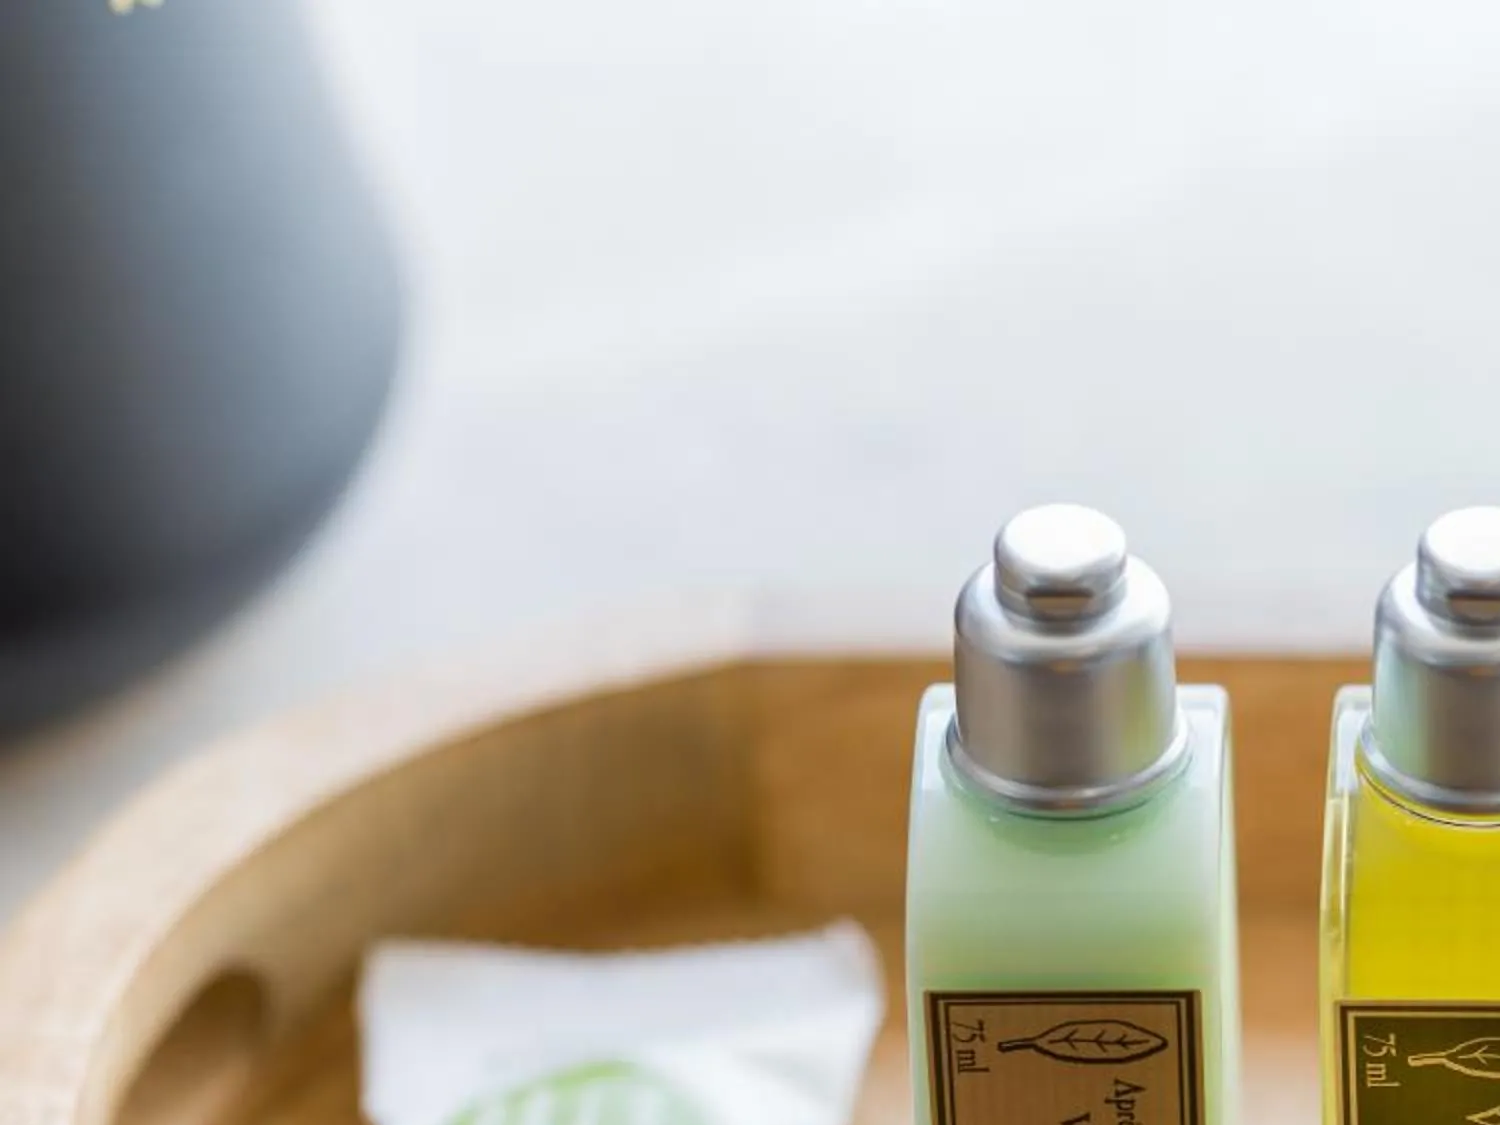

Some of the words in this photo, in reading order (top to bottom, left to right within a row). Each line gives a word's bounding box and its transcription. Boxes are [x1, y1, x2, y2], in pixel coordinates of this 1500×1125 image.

[952, 1019, 983, 1044] 75
[1363, 1033, 1396, 1057] 75
[957, 1049, 989, 1073] ml
[1366, 1063, 1398, 1087] ml
